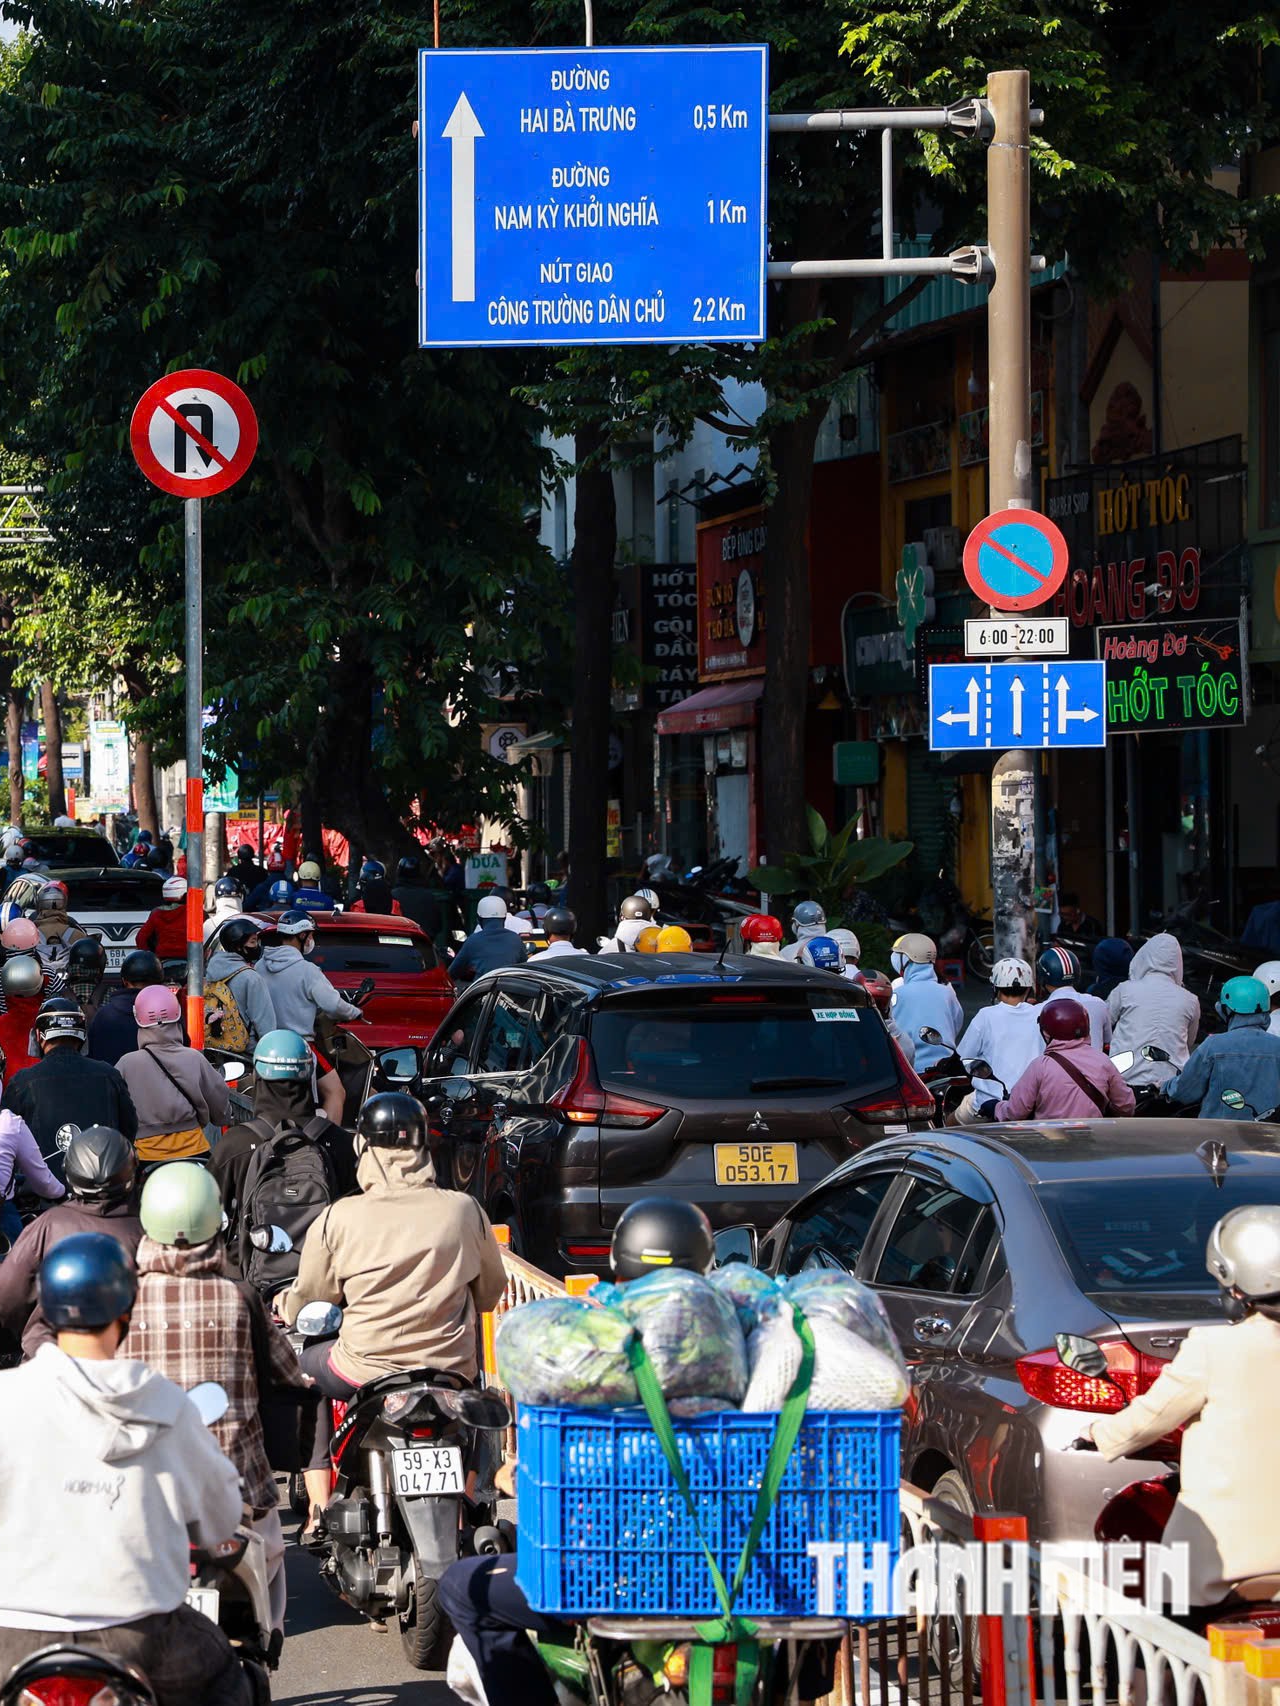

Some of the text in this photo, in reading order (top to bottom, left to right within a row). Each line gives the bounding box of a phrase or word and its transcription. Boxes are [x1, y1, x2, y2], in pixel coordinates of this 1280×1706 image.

[551, 64, 610, 91] ĐƯỜNG
[520, 102, 748, 133] HAI BÀ TRƯNG 0,5 Km
[552, 162, 610, 188] ĐƯỜNG
[494, 195, 747, 229] NAM KỲ KHỞI NGHĨA 1 Km
[540, 258, 613, 283] NÚT GIAO
[488, 290, 746, 325] CÔNG TRƯỜNG DÂN CHỦ 2,2 Km
[1104, 635, 1159, 663] Hoàng
[1107, 662, 1238, 722] HỚT TÓC
[739, 1147, 774, 1162] 50E
[726, 1165, 788, 1182] 053.17
[403, 1450, 452, 1470] 59-X3
[400, 1471, 458, 1492] 047.71
